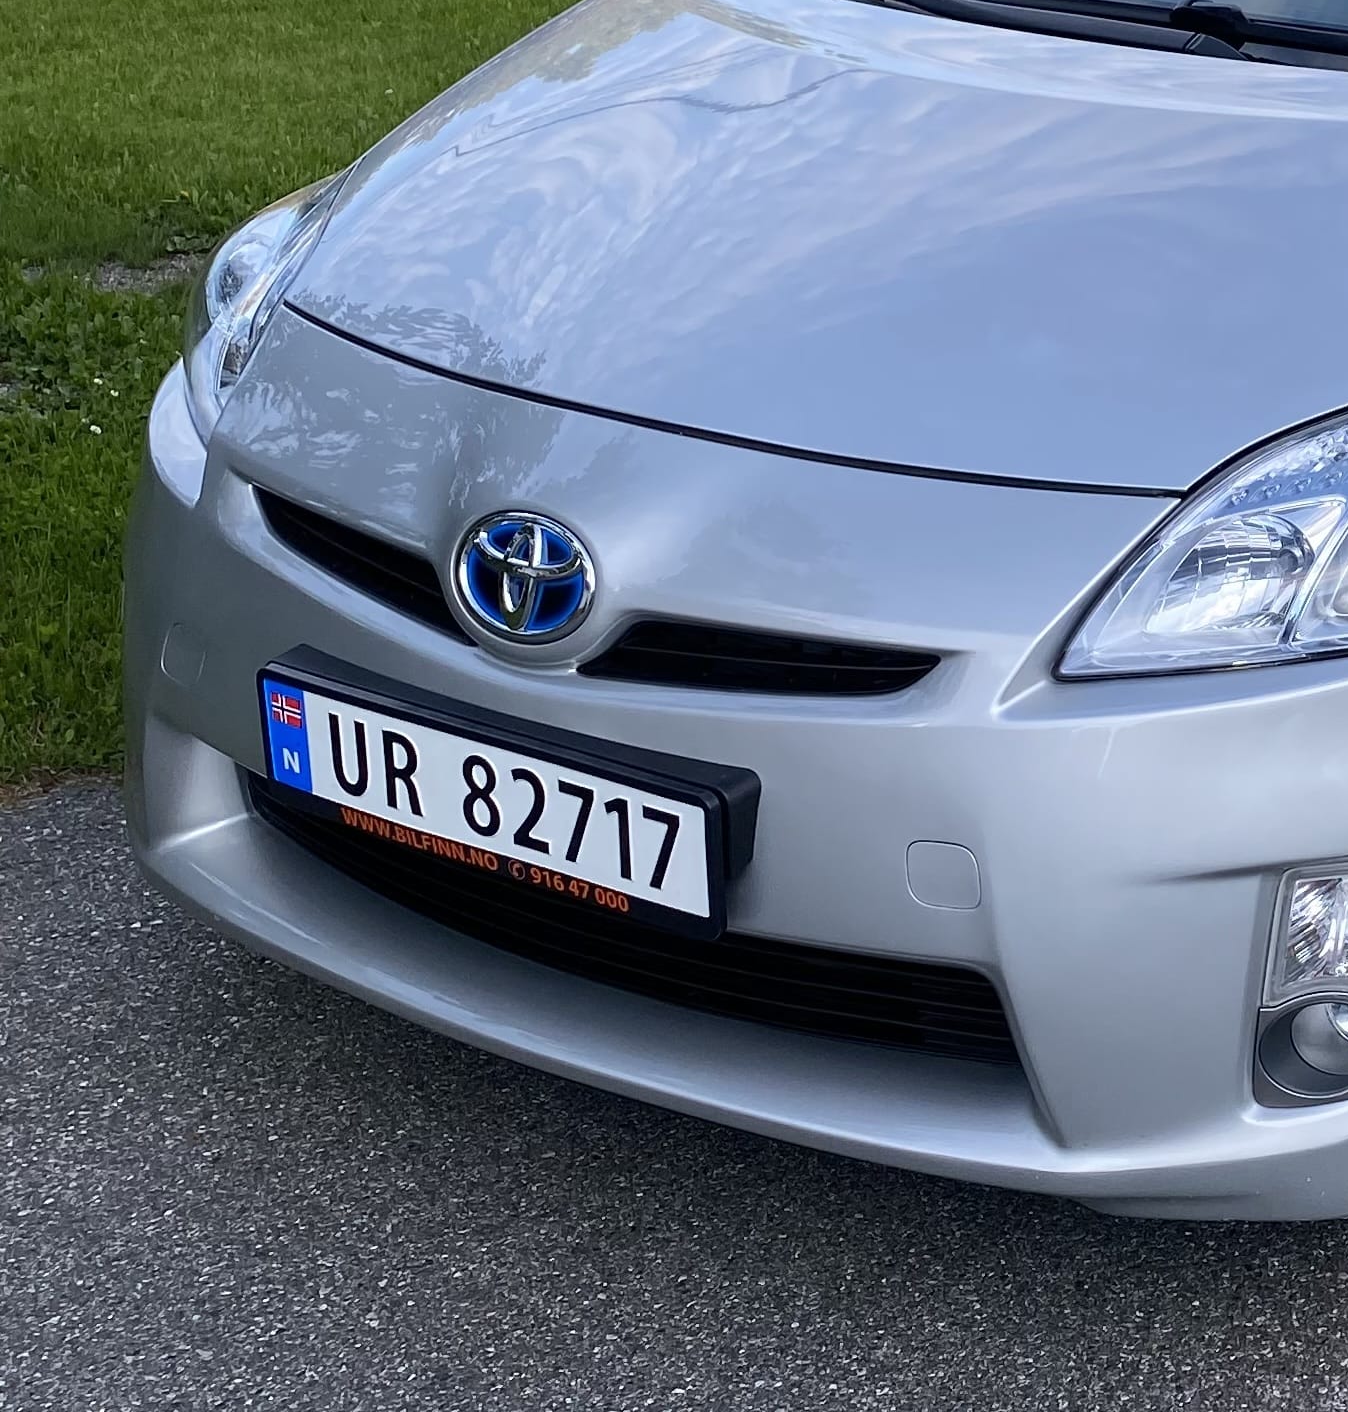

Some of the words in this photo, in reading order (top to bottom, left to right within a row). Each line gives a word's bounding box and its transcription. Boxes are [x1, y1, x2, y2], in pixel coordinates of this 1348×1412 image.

[282, 747, 301, 774] N
[328, 712, 424, 818] UR
[462, 754, 681, 890] 82717
[339, 806, 499, 872] WWW.BILFINN.NO
[530, 867, 563, 892] 916
[568, 879, 590, 900] 47
[594, 888, 630, 913] 000
